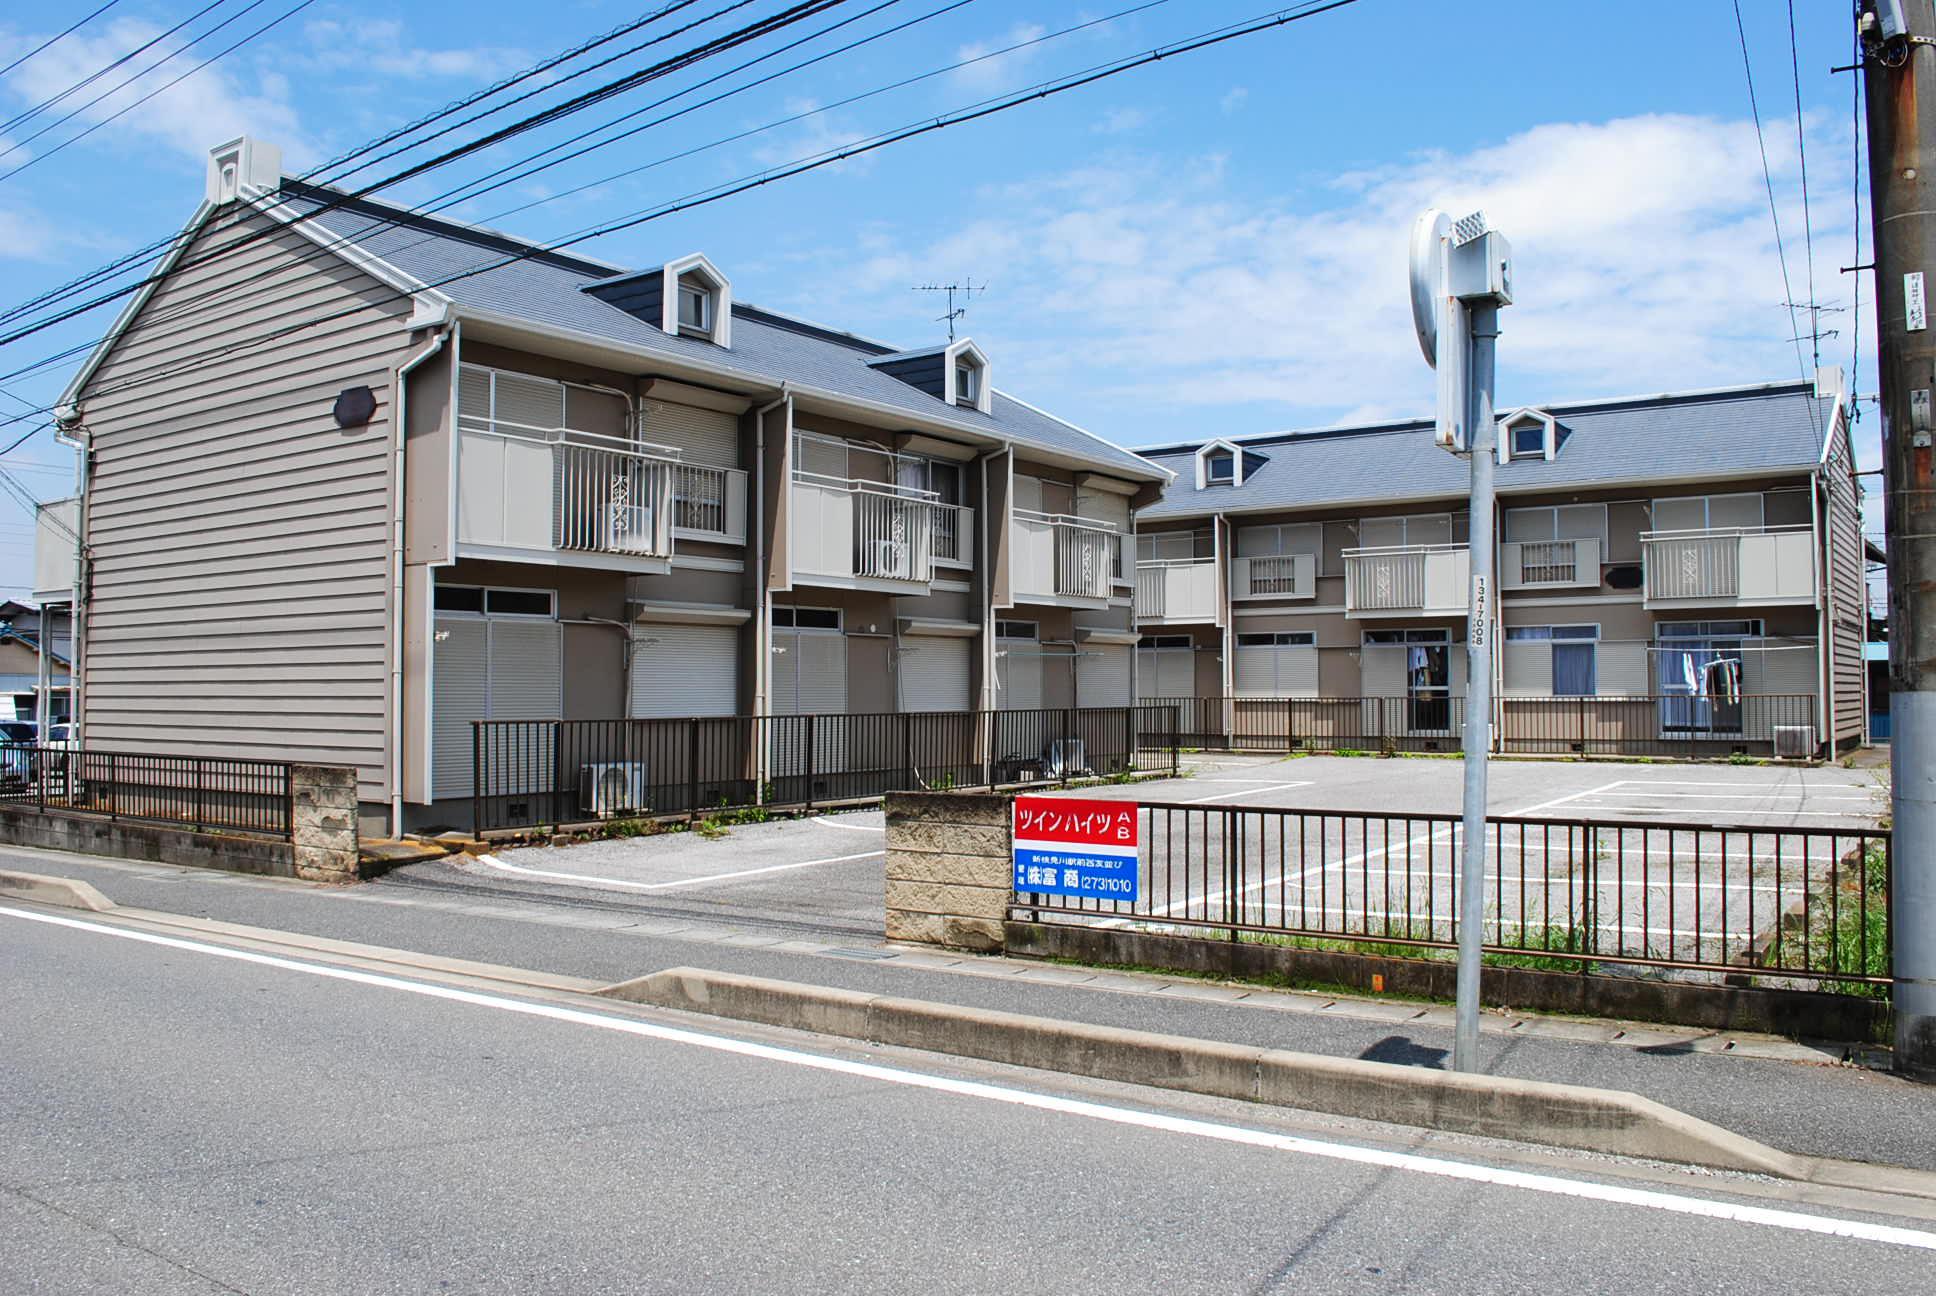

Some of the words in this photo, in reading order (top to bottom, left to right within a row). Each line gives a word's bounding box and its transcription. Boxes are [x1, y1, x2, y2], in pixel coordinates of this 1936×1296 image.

[1019, 809, 1111, 834] ツインハイツ
[1117, 811, 1131, 823] A
[1117, 826, 1131, 839] B
